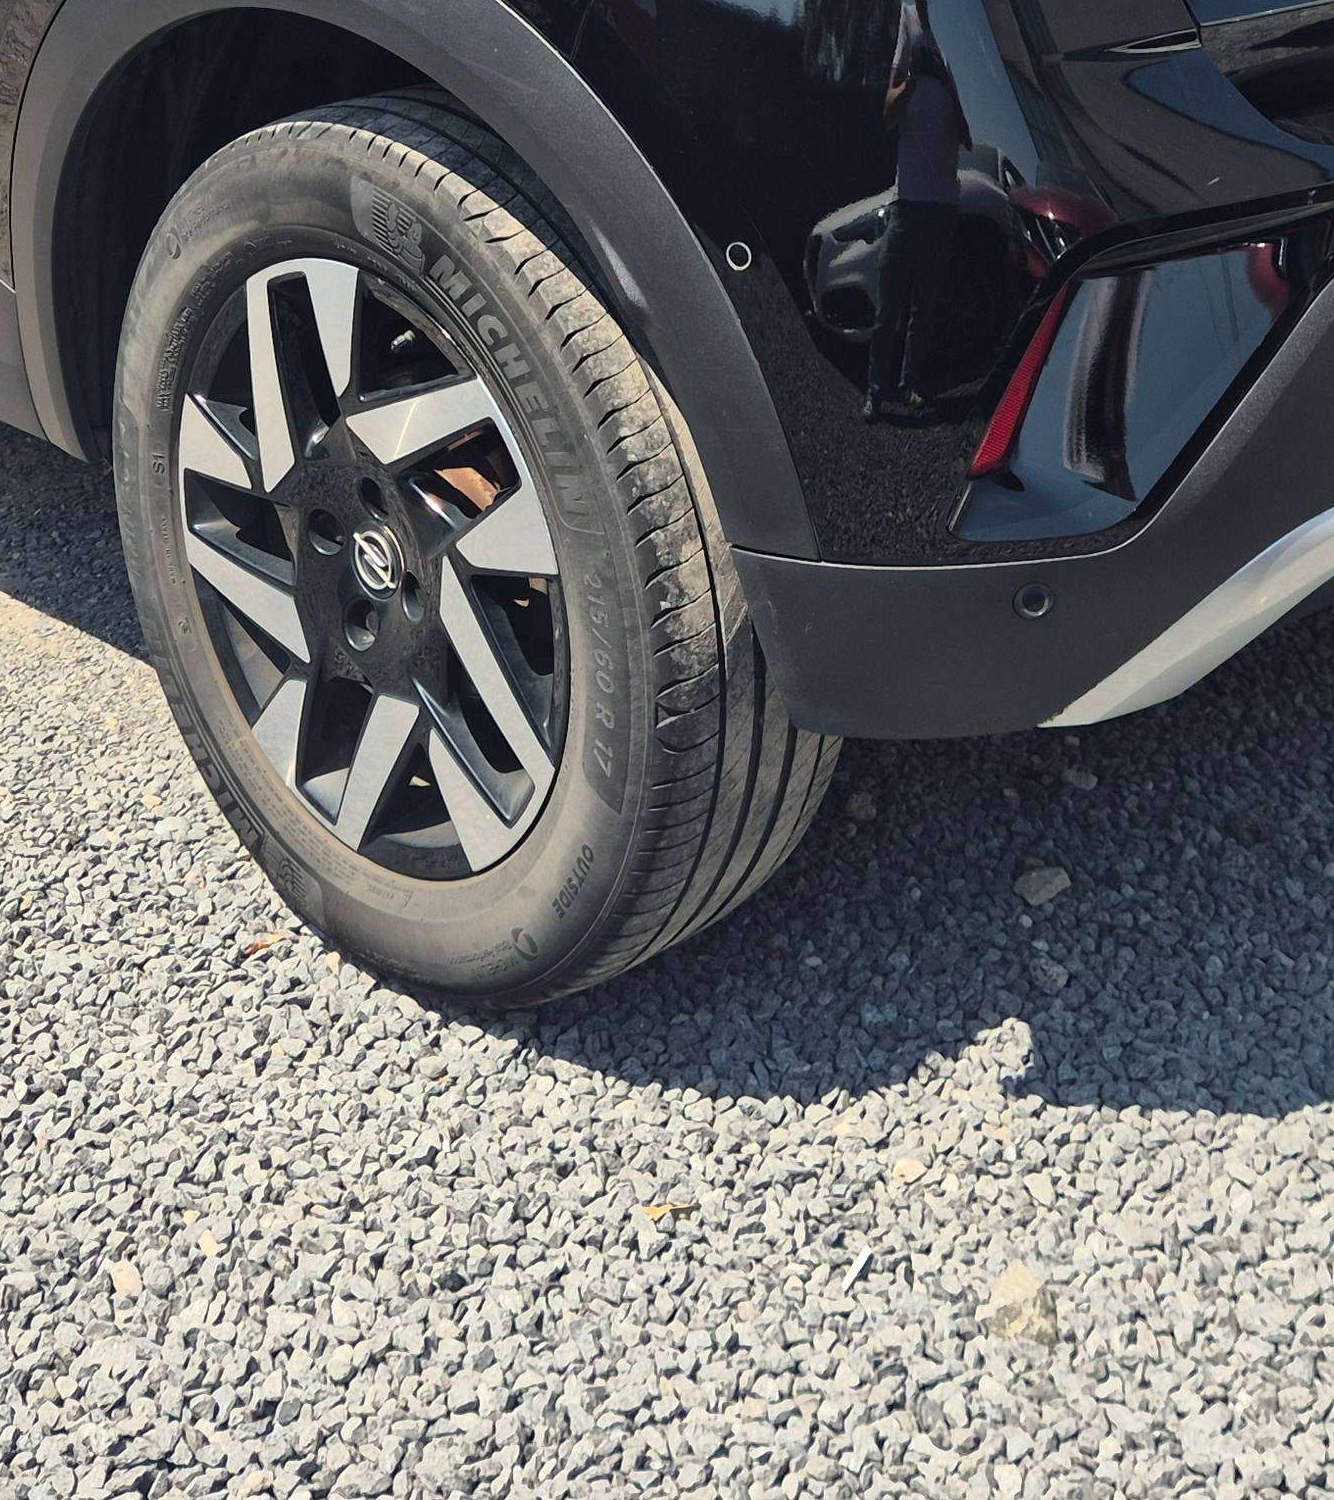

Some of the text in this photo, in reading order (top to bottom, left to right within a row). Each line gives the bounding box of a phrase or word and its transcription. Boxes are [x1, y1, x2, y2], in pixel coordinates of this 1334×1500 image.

[428, 253, 590, 517] MICHELIN
[595, 701, 616, 730] R
[593, 738, 615, 779] 17
[552, 843, 595, 920] OUTSIDE
